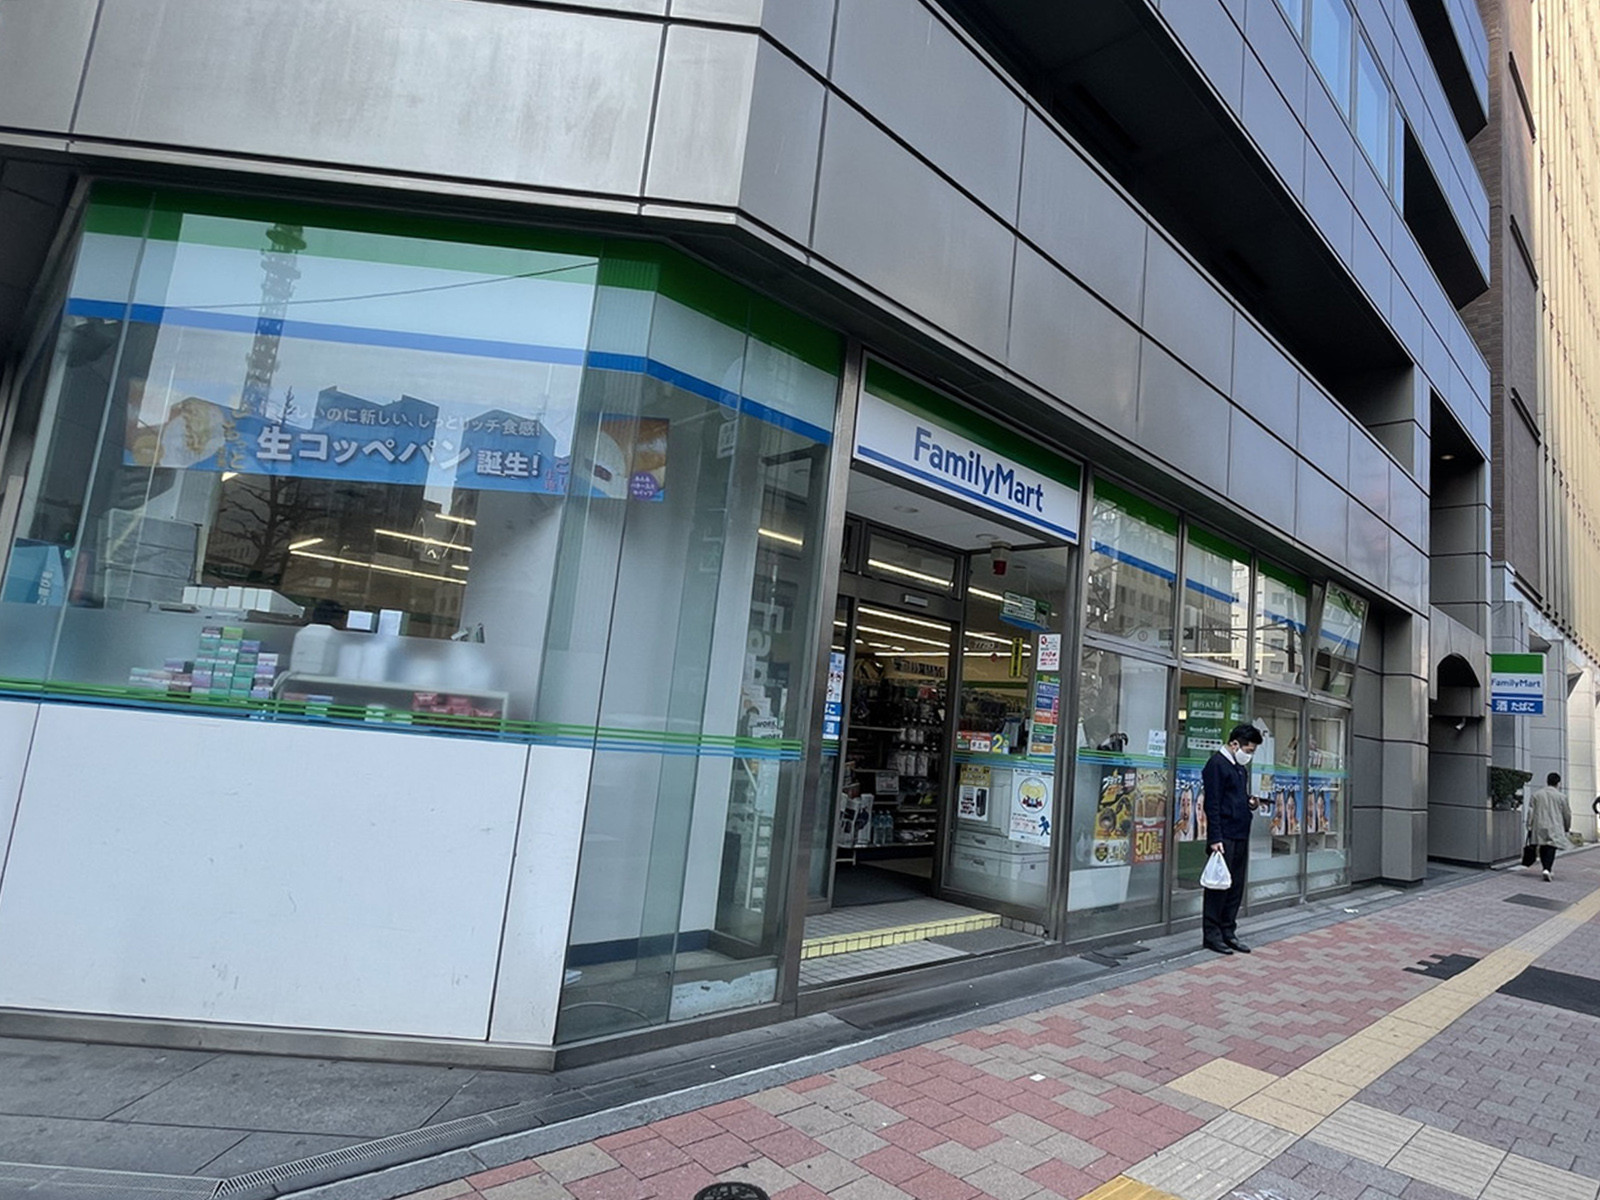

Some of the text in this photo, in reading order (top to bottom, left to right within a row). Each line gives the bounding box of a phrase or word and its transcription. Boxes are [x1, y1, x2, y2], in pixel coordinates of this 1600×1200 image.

[913, 426, 1044, 513] FamilyMart
[1491, 678, 1541, 688] FamilyMart
[1496, 699, 1536, 712] 酒 たばこ
